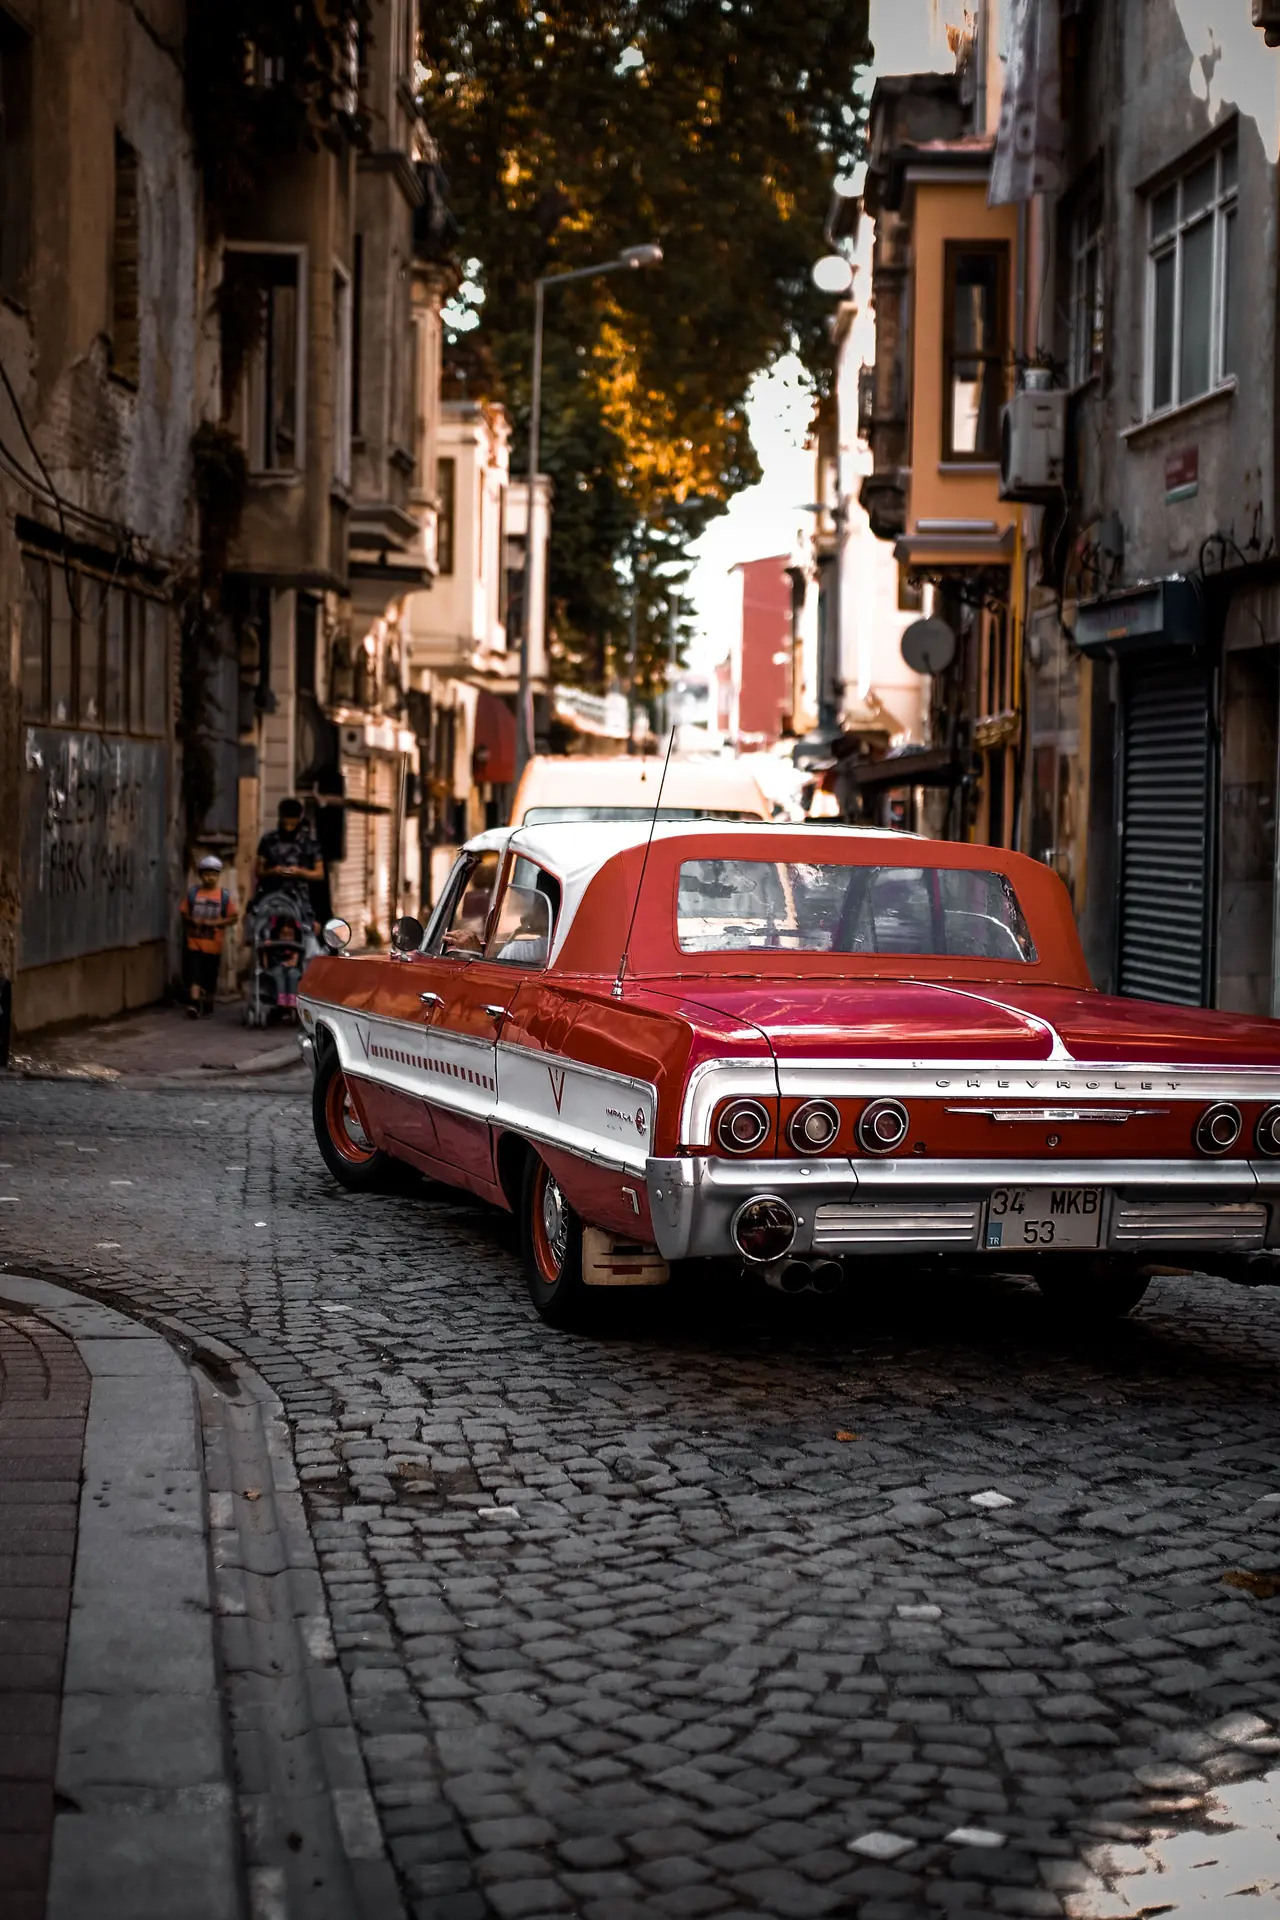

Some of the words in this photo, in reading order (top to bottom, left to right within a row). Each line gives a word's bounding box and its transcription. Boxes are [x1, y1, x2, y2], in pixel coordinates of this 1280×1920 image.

[936, 1079, 1181, 1090] CHEVROLET
[605, 1108, 634, 1123] IMPALA
[993, 1191, 1025, 1215] 34
[1050, 1190, 1098, 1214] MKB
[1023, 1220, 1056, 1243] 53
[989, 1237, 1000, 1245] TR
